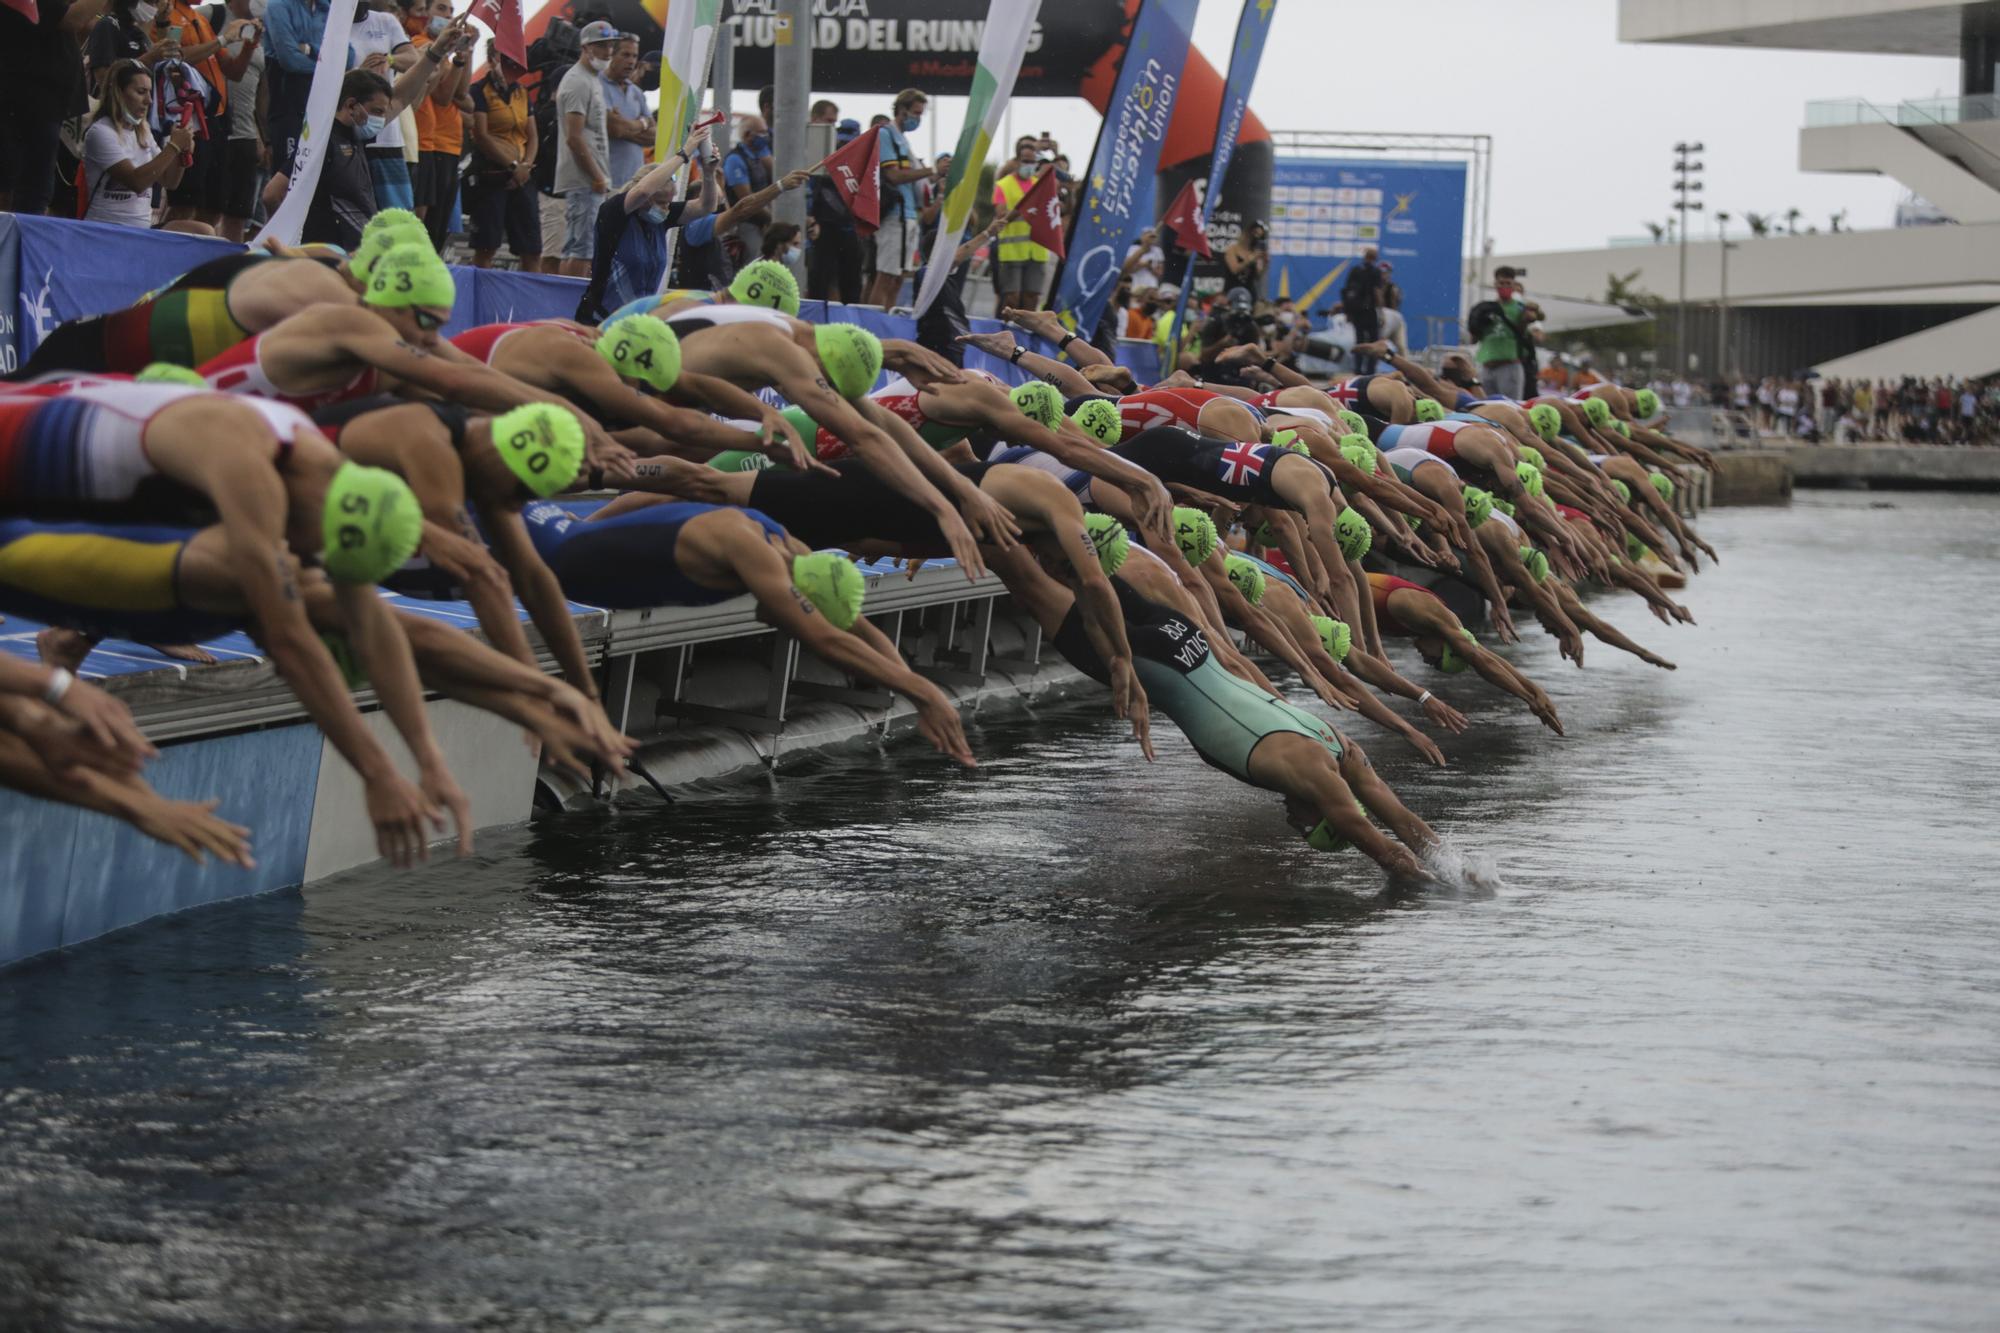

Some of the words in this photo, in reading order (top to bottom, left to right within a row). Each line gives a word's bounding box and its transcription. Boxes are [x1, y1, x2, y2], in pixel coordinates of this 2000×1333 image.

[726, 15, 842, 49] CIUD
[846, 18, 903, 51] DEL
[906, 20, 1044, 52] RUNNG
[1146, 73, 1176, 142] Union
[1102, 94, 1137, 213] European
[1114, 58, 1161, 219] Triathlon
[373, 271, 413, 292] 63
[747, 282, 781, 310] 61
[613, 339, 653, 370] 64
[1082, 413, 1107, 439] 38
[510, 429, 551, 474] 60
[339, 492, 369, 549] 56
[1178, 522, 1195, 552] 44
[1158, 618, 1189, 641] POR
[1173, 630, 1209, 668] SILVA
